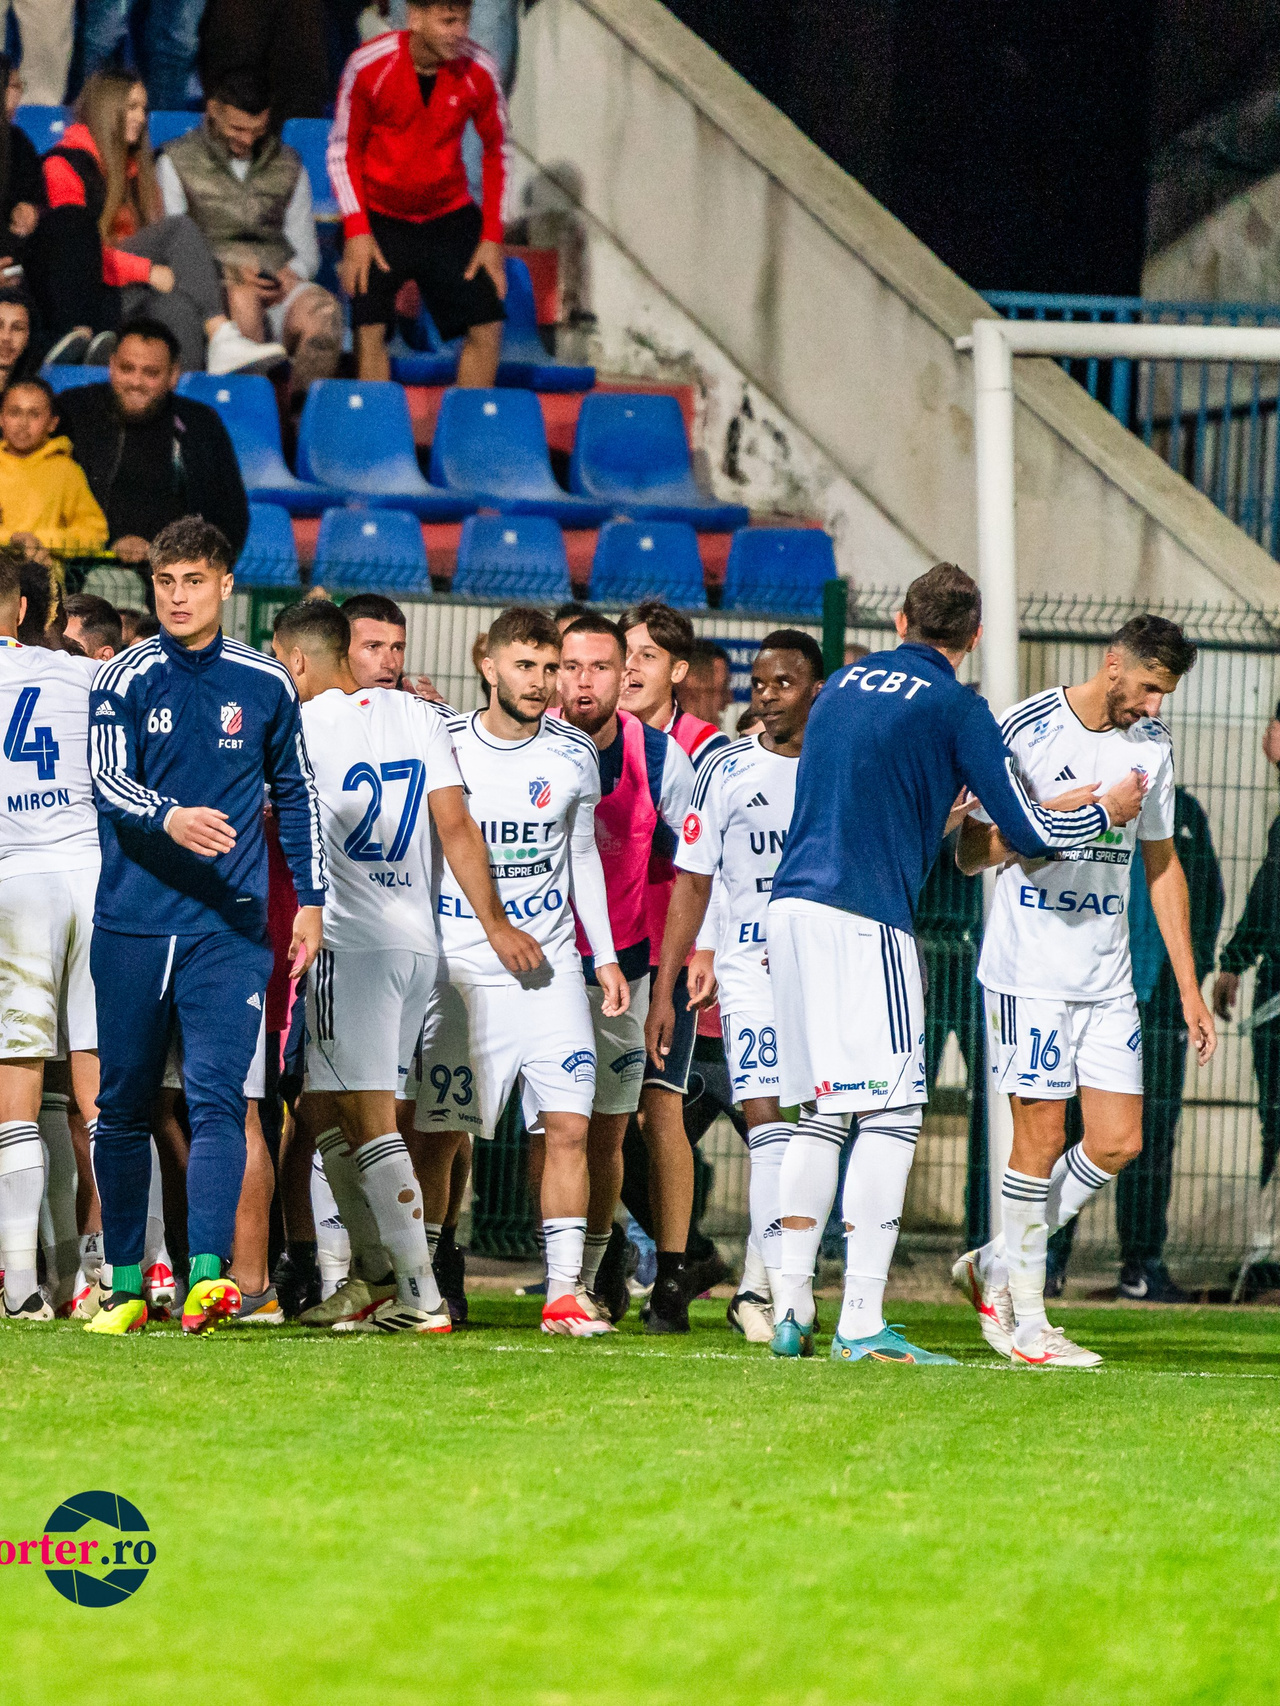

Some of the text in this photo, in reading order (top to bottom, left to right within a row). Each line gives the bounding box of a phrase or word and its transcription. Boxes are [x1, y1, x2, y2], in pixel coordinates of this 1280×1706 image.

[839, 666, 933, 700] FCBT
[147, 708, 173, 734] 68
[3, 687, 61, 781] 4
[218, 738, 244, 749] FCBT
[7, 788, 70, 813] MIRON
[342, 758, 427, 863] 27
[481, 820, 558, 844] IBET
[507, 865, 532, 878] SPRE
[533, 862, 547, 874] 0%
[437, 889, 563, 920] ELACO
[738, 1026, 779, 1070] 28
[1030, 1027, 1061, 1071] 16
[430, 1064, 473, 1106] 93
[759, 1076, 780, 1084] Vest
[832, 1079, 889, 1092] Smart Eco
[871, 1088, 889, 1096] Plus
[1046, 1079, 1072, 1088] Vestra
